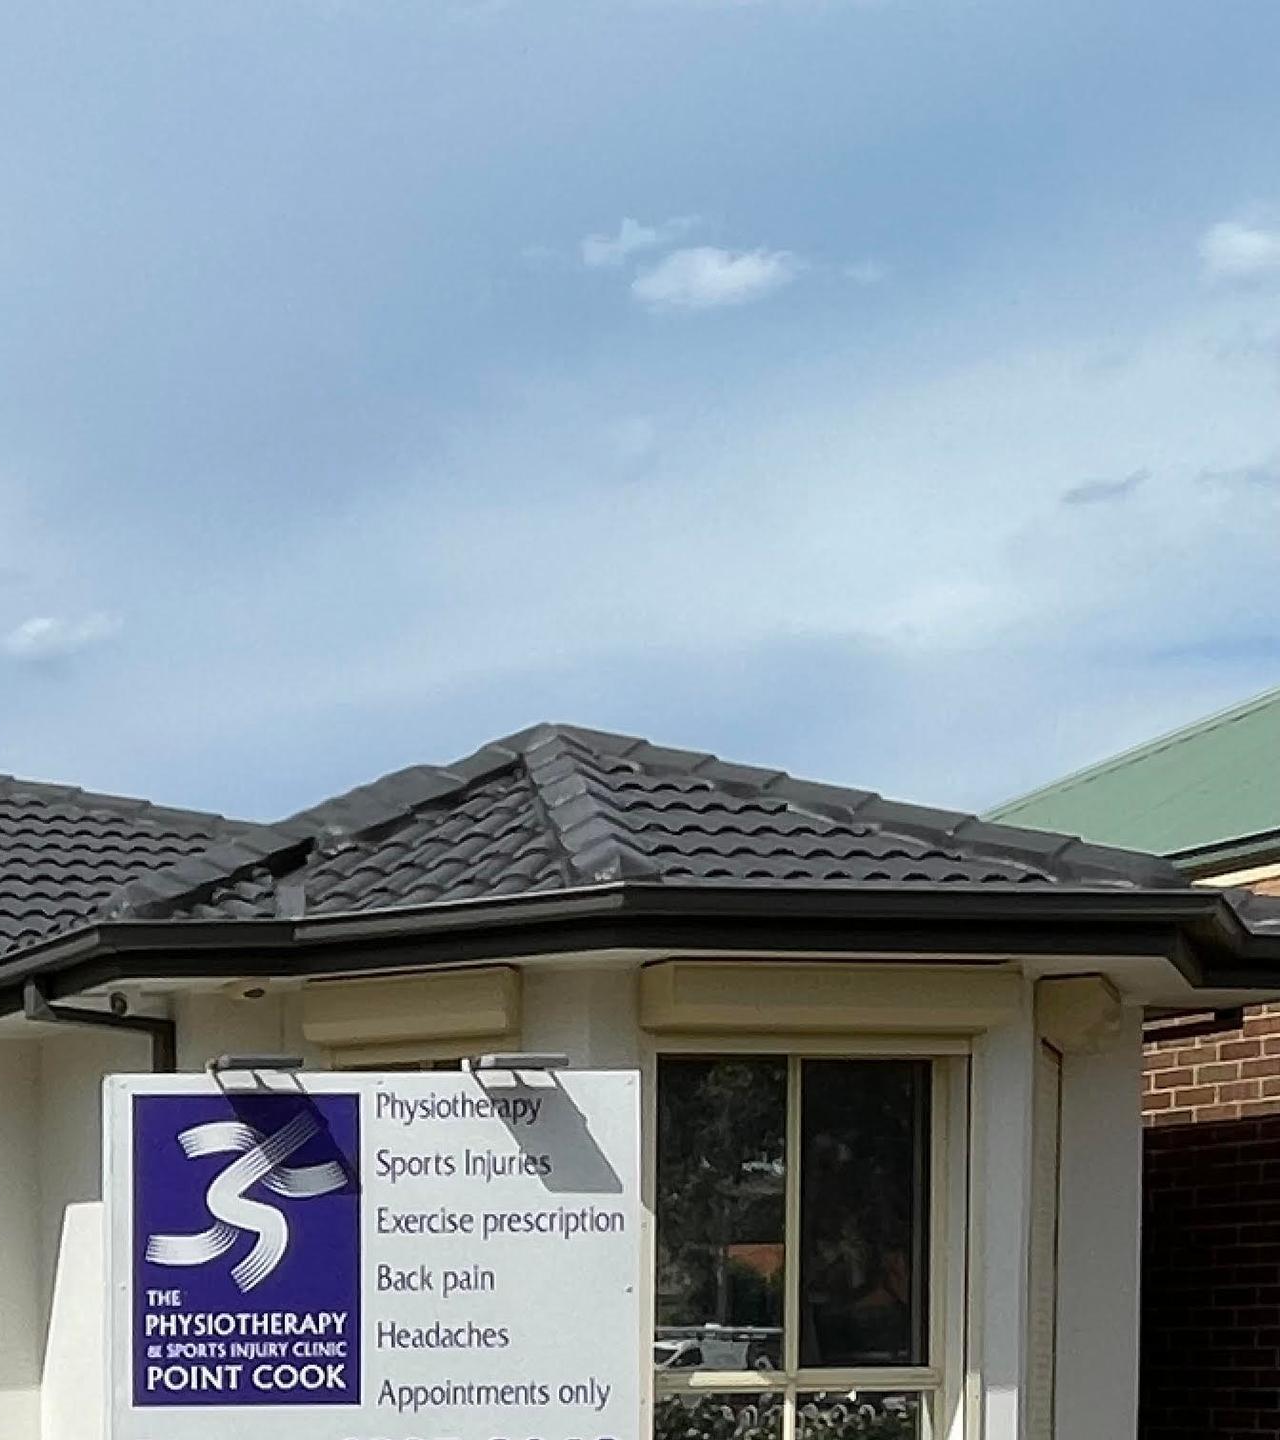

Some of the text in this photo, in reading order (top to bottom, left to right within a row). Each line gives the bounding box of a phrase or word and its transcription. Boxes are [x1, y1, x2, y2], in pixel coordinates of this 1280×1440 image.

[376, 1091, 542, 1125] Physiotherapy
[376, 1149, 553, 1184] Sports Injuries
[377, 1205, 625, 1240] Exercise prescription
[377, 1264, 495, 1298] Back pain
[146, 1290, 182, 1306] THE
[145, 1312, 348, 1336] PHYSIOTHERAPY
[377, 1321, 510, 1349] Headaches
[166, 1342, 226, 1358] SPORTS
[230, 1342, 289, 1360] INJURY
[292, 1341, 347, 1358] CLINIC
[147, 1363, 346, 1391] POINT COOK
[377, 1377, 611, 1413] Appointments only
